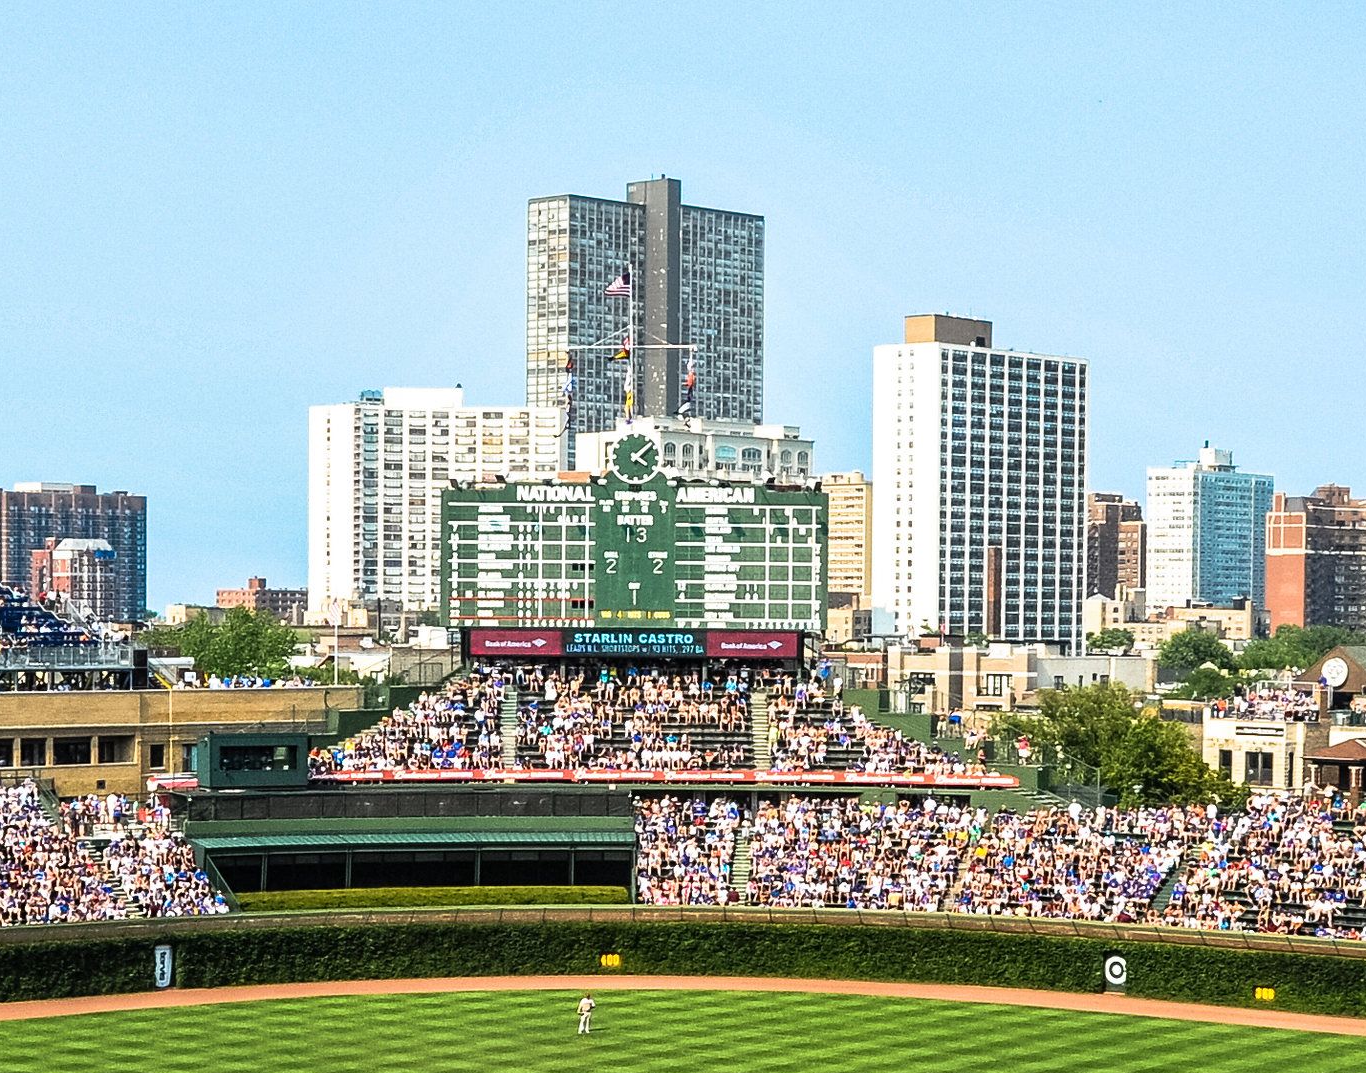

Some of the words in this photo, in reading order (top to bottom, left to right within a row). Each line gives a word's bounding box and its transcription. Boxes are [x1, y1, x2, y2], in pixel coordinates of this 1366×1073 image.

[516, 485, 596, 501] NATIONAL
[675, 487, 755, 503] AMERICAN
[617, 515, 653, 525] BATTER
[626, 527, 647, 542] 13
[606, 559, 617, 574] 2
[653, 559, 664, 574] 2
[506, 640, 532, 648] America
[574, 633, 632, 644] STARLIN
[638, 633, 694, 644] CASTRO
